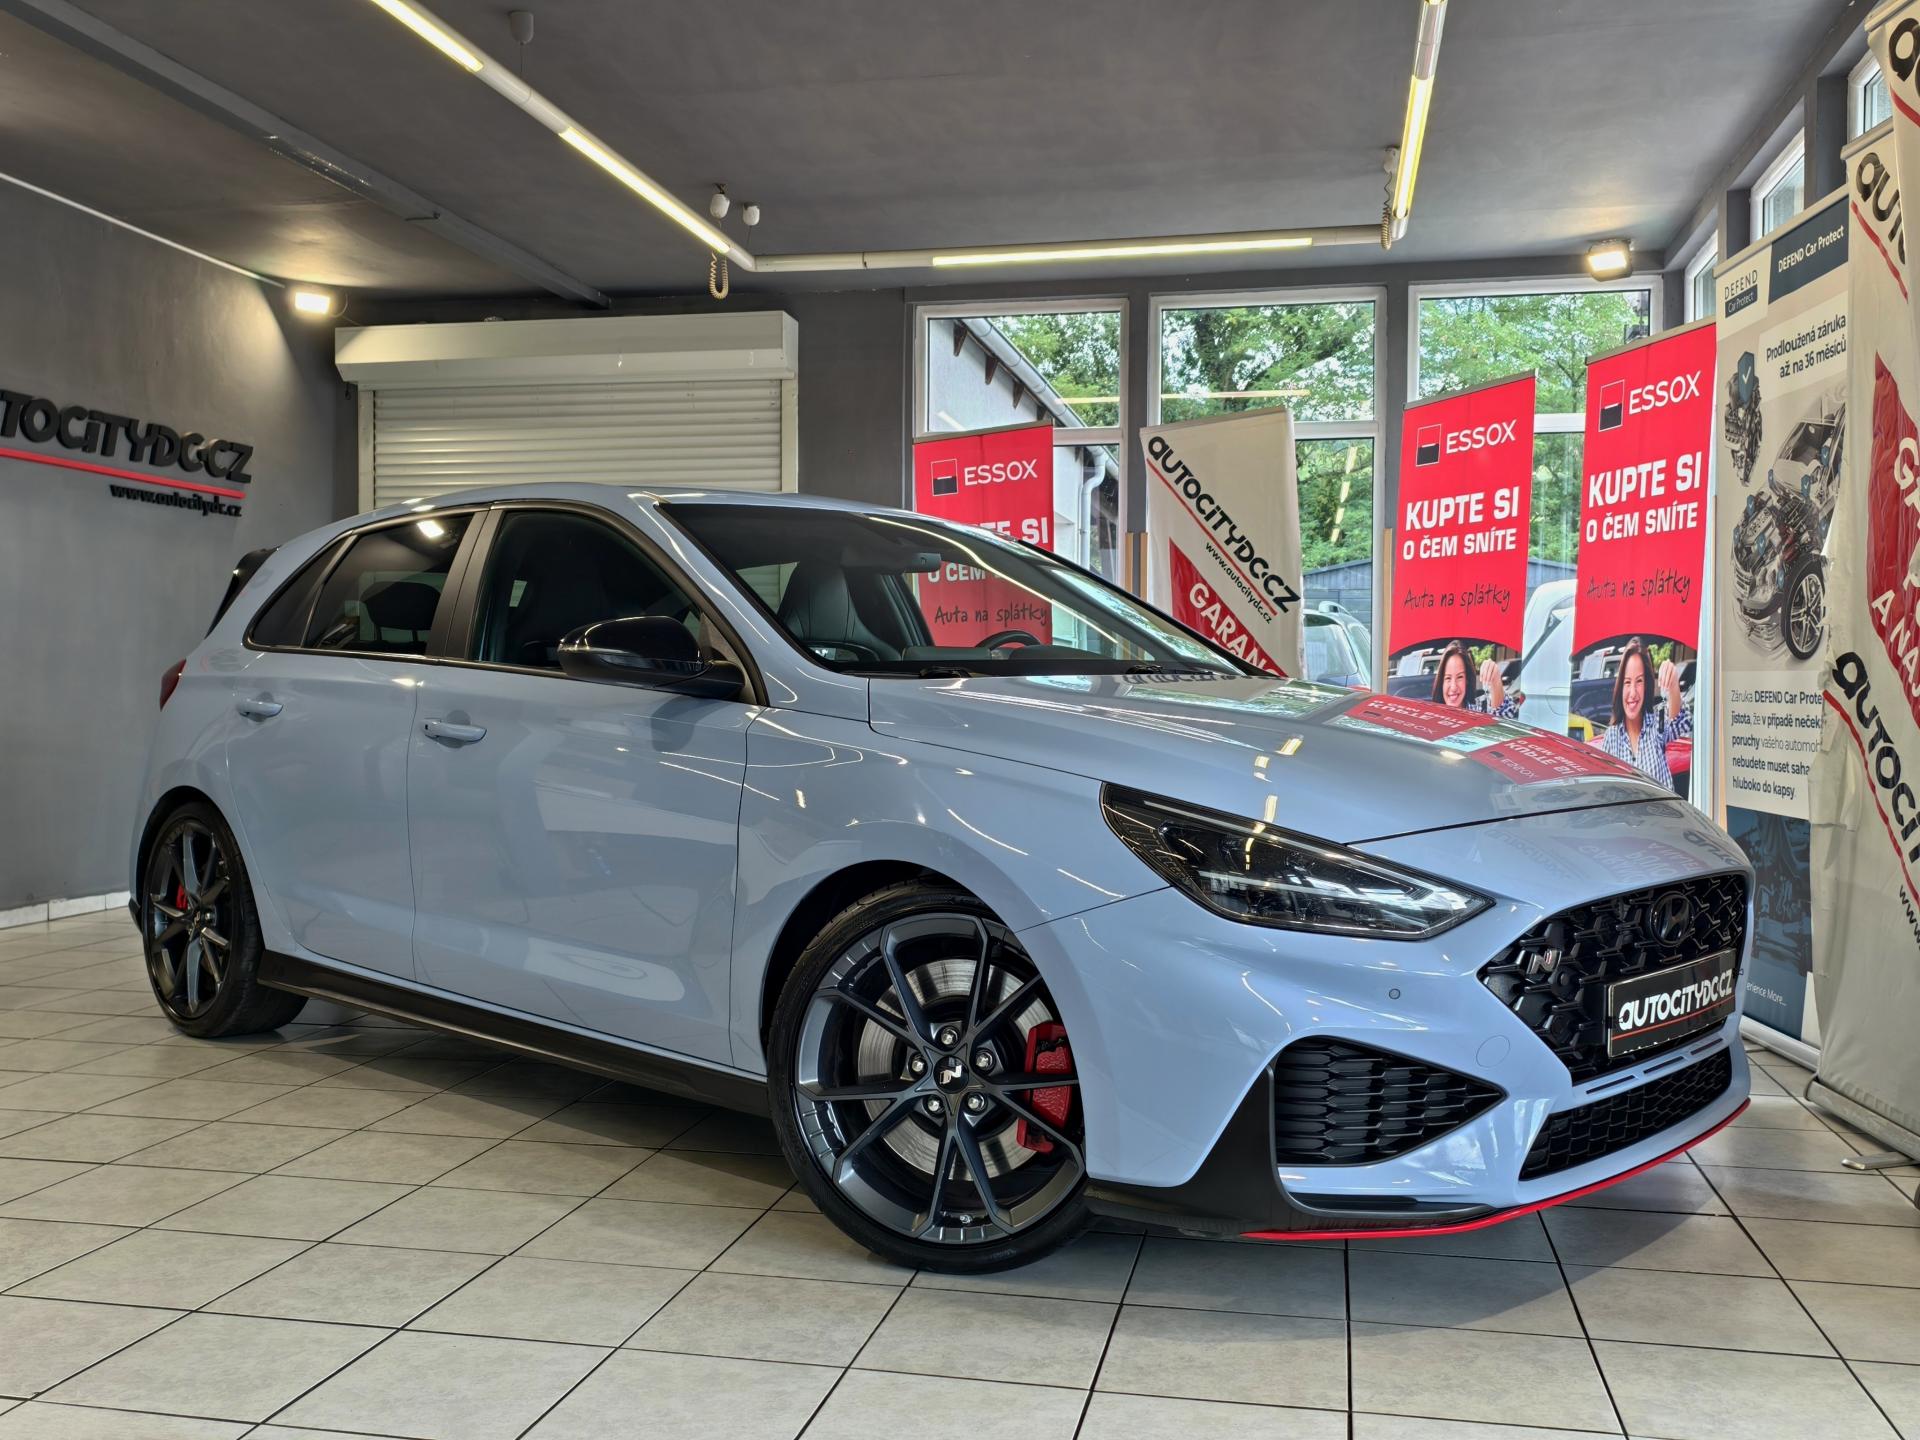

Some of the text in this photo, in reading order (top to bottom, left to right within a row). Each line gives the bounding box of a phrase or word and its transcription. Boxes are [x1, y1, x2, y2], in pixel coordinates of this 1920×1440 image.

[1778, 225, 1845, 273] DEFEND Car Protect
[1724, 269, 1758, 300] DEFEND
[1766, 314, 1846, 363] Prodloužená záruka
[1779, 334, 1847, 378] až na 36 měsíců
[1629, 371, 1702, 415] ESSOX
[1446, 419, 1518, 454] ESSOX
[963, 458, 1038, 486] ESSOX
[1588, 451, 1702, 508] KUPTE SI
[1405, 486, 1520, 531] KUPTE SI
[1586, 500, 1699, 543] O ČEM SNÍTE
[1021, 516, 1049, 545] SI
[1402, 528, 1518, 561] O ČEM SNÍTE
[1205, 542, 1273, 625] www.autocitydc.cz
[1403, 582, 1511, 615] Auta na splátky
[1586, 568, 1691, 604] Auta na splátky
[934, 602, 1048, 628] Auta na splátky
[1189, 582, 1280, 676] GARAN
[1731, 689, 1823, 705] Záruka DEFEND Car Prote
[1761, 716, 1766, 725] v
[1795, 714, 1823, 729] neček
[1732, 733, 1760, 750] poruchy
[1761, 735, 1784, 750] vašeho
[1732, 755, 1766, 770] nebudete
[1767, 761, 1789, 773] muset
[1732, 776, 1761, 792] hluboko
[1762, 781, 1772, 793] do
